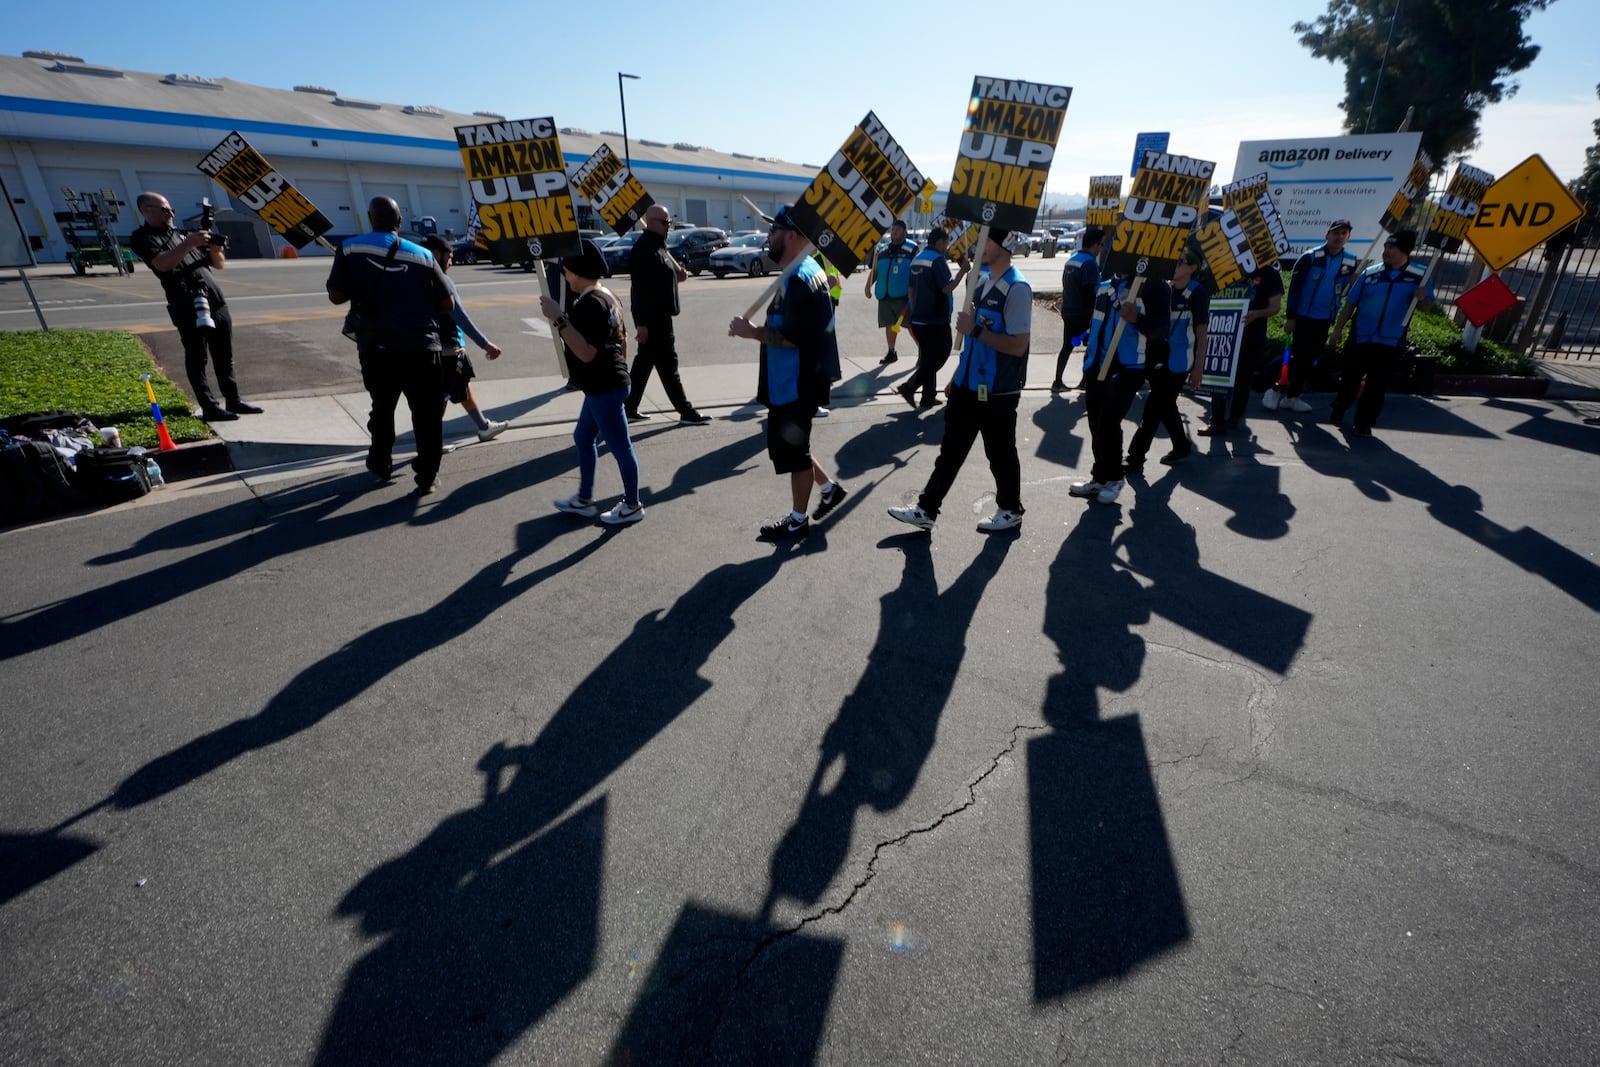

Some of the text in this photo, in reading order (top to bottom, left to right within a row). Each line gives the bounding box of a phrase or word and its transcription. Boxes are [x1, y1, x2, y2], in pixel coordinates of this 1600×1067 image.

[976, 77, 1067, 108] TANNC
[458, 118, 553, 146] TANNC
[970, 101, 1062, 142] AMAZON
[199, 134, 246, 175] TANNC
[469, 140, 560, 178] AMAZON
[571, 144, 611, 187] TANNC
[864, 114, 924, 192] TANNC
[959, 132, 1054, 167] ULP
[1145, 151, 1215, 179] TANNC
[1258, 148, 1392, 163] amazon Delivery
[218, 148, 270, 196] AMAZON
[239, 170, 284, 211] ULP
[470, 171, 569, 204] ULP
[581, 152, 622, 199] AMAZON
[591, 167, 631, 211] ULP
[828, 150, 894, 228] ULP
[845, 133, 913, 215] AMAZON
[952, 157, 1048, 209] STRIKE
[1089, 184, 1120, 198] AMAZON
[1090, 176, 1121, 184] TANNC
[1134, 171, 1207, 206] AMAZON
[1224, 173, 1266, 194] TANNC
[1333, 187, 1376, 195] Associates
[1460, 163, 1494, 187] TANNC
[259, 187, 317, 234] STRIKE
[479, 195, 578, 241] STRIKE
[600, 177, 646, 227] STRIKE
[805, 172, 881, 260] STRIKE
[1087, 209, 1118, 225] STRIKE
[1088, 198, 1120, 209] ULP
[1124, 197, 1197, 227] ULP
[1441, 193, 1478, 217] ULP
[1474, 202, 1556, 228] END
[1112, 220, 1190, 260] STRIKE
[1220, 210, 1257, 273] ULP
[1237, 203, 1276, 262] AMAZON
[1257, 192, 1289, 254] TANNC
[1196, 221, 1242, 289] STRIKE
